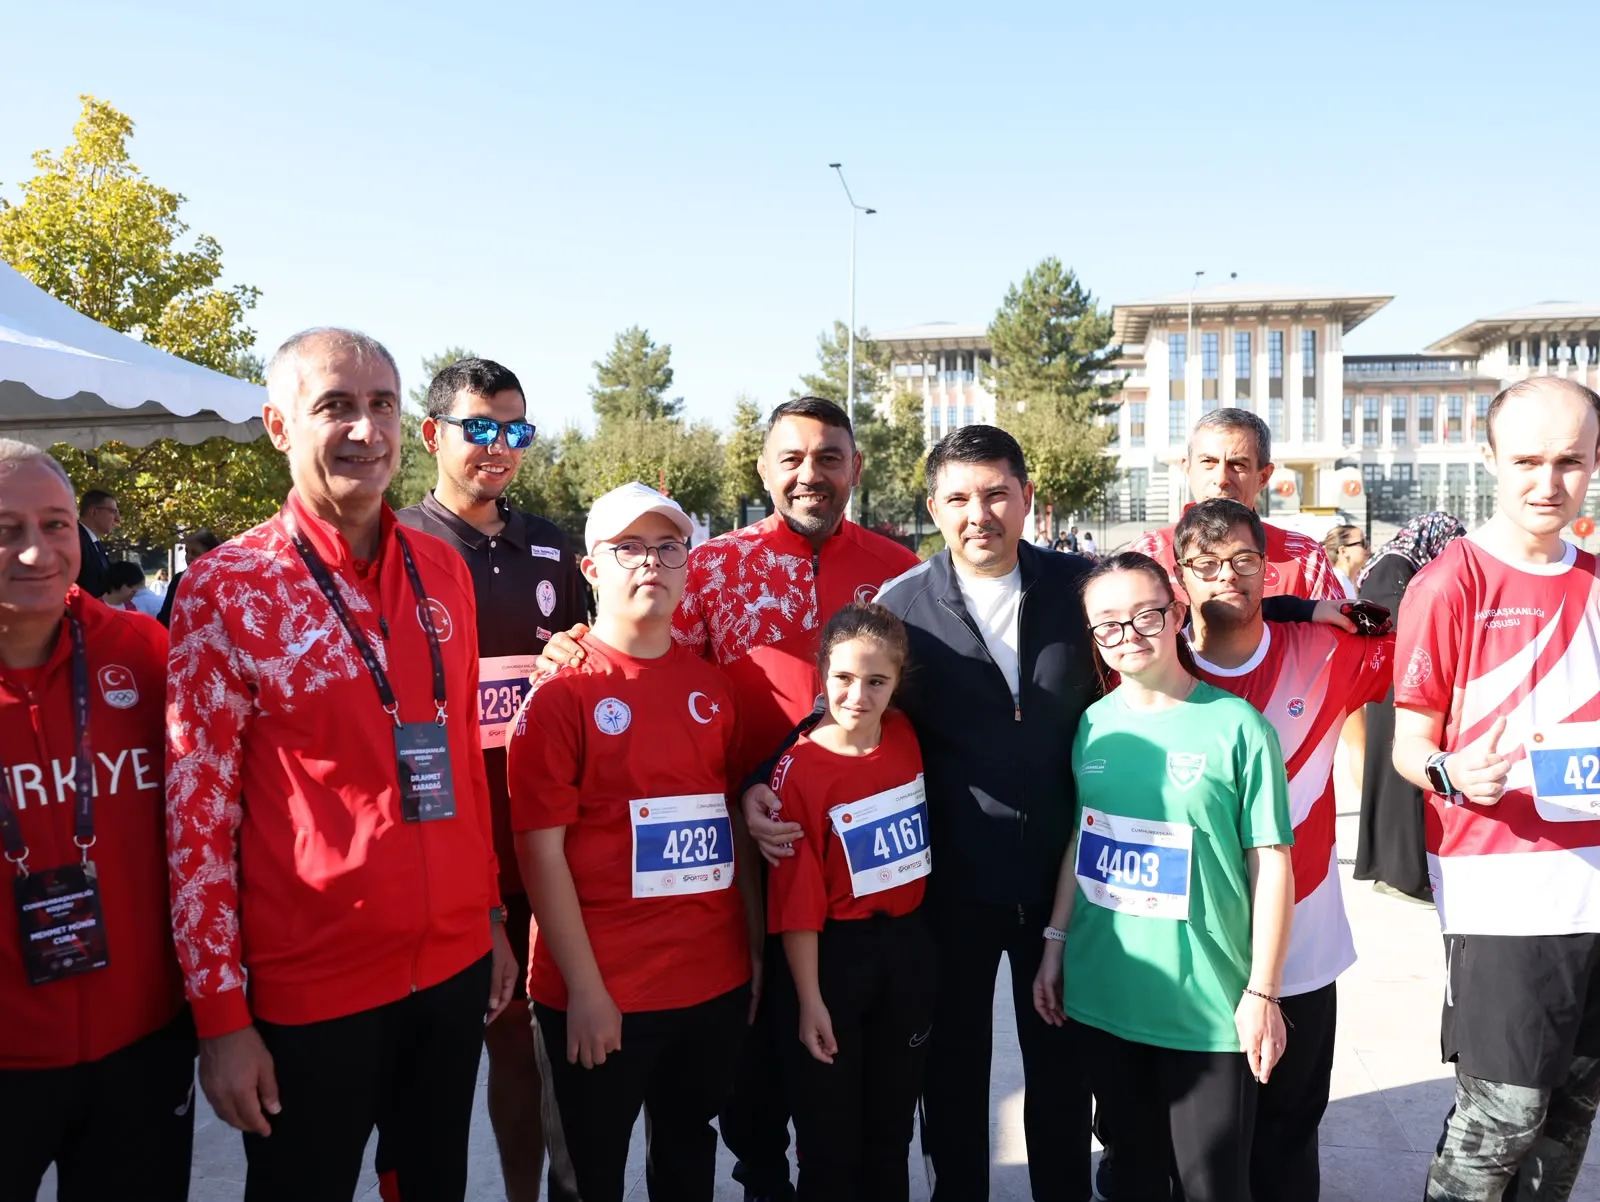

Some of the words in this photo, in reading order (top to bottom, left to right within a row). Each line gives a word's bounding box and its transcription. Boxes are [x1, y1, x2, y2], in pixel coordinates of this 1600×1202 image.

[1563, 754, 1600, 790] 42
[662, 825, 719, 864] 4232
[873, 812, 925, 860] 4167
[1095, 844, 1160, 888] 4403
